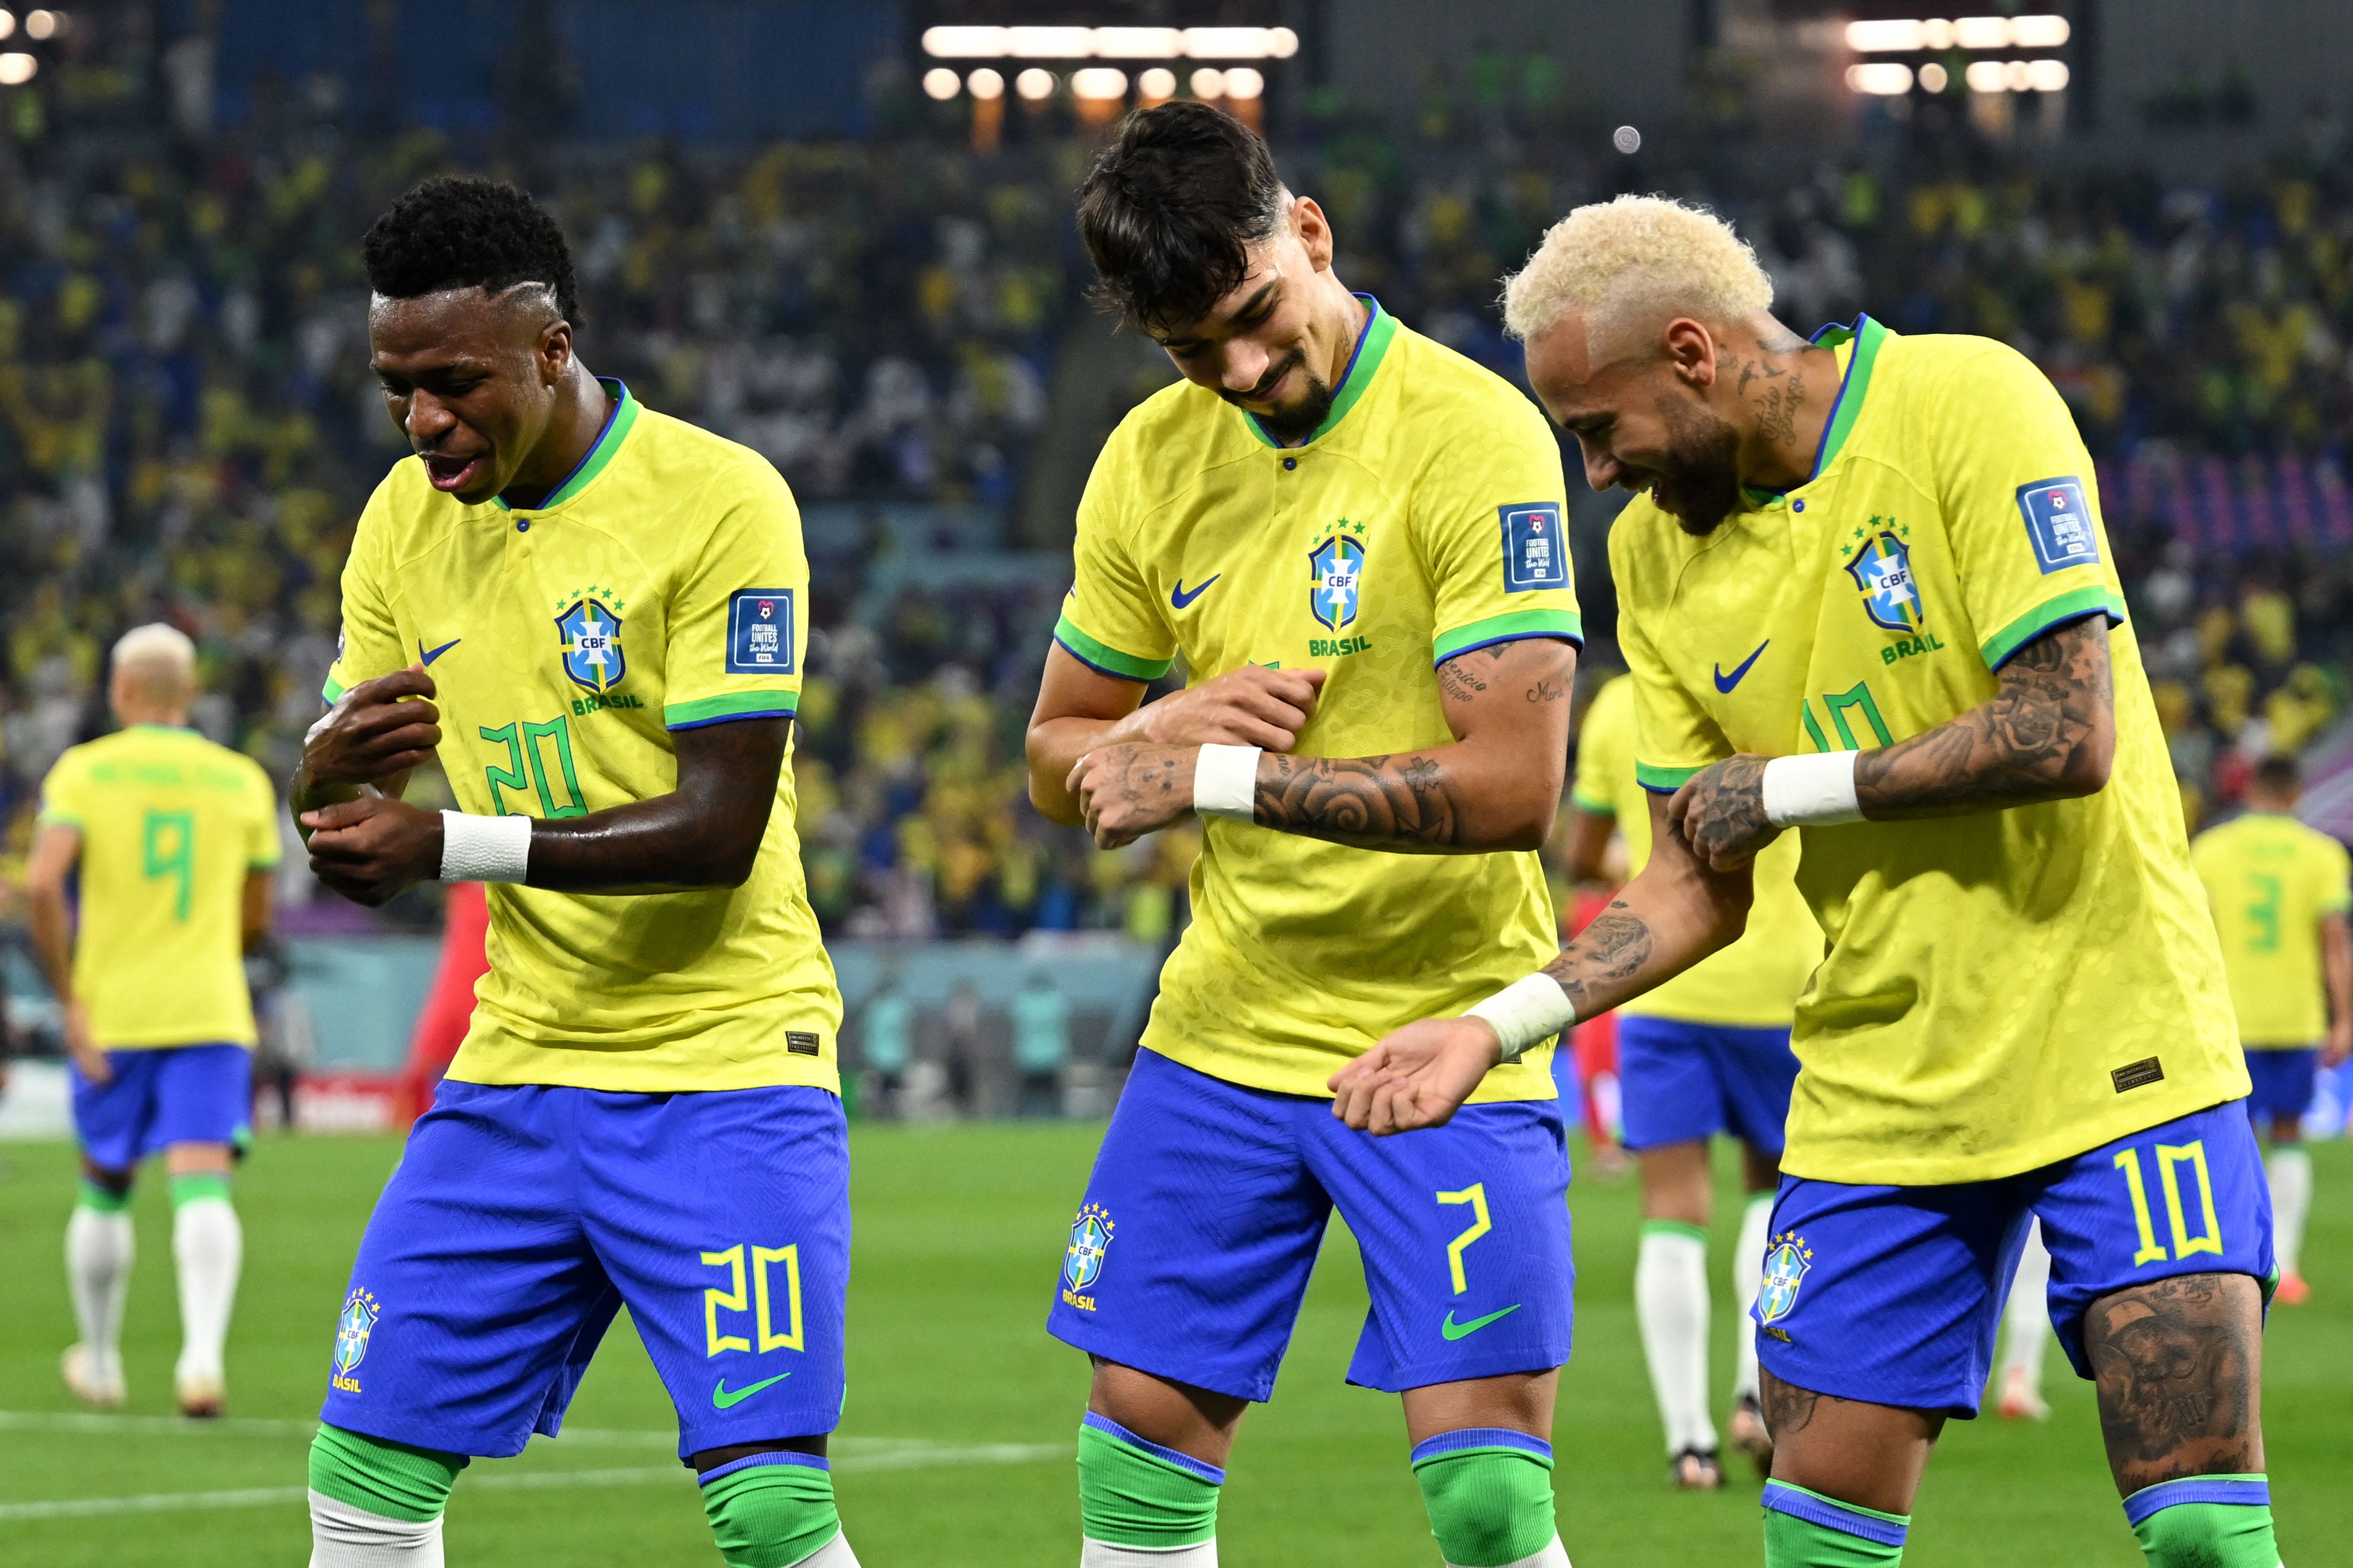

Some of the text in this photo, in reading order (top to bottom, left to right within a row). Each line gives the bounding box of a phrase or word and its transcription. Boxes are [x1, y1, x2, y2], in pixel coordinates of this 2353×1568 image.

[1328, 576, 1352, 587] CBF
[1880, 570, 1907, 589] CBF
[751, 623, 777, 632] FOOTBALL
[751, 632, 777, 643] UNITES
[581, 638, 606, 649] CBF
[749, 643, 779, 652] the World
[1309, 635, 1372, 657] BRASIL
[571, 694, 644, 717] BRASIL
[479, 714, 589, 819] 20
[144, 810, 193, 921] 9
[2245, 872, 2282, 955] 3
[2113, 1139, 2224, 1268] 10
[1435, 1181, 1493, 1296] 7
[1078, 1246, 1093, 1257] CBF
[1773, 1276, 1788, 1288] CBF
[699, 1242, 805, 1359] 20
[1062, 1288, 1097, 1312] BRASIL
[347, 1330, 360, 1340] CBF
